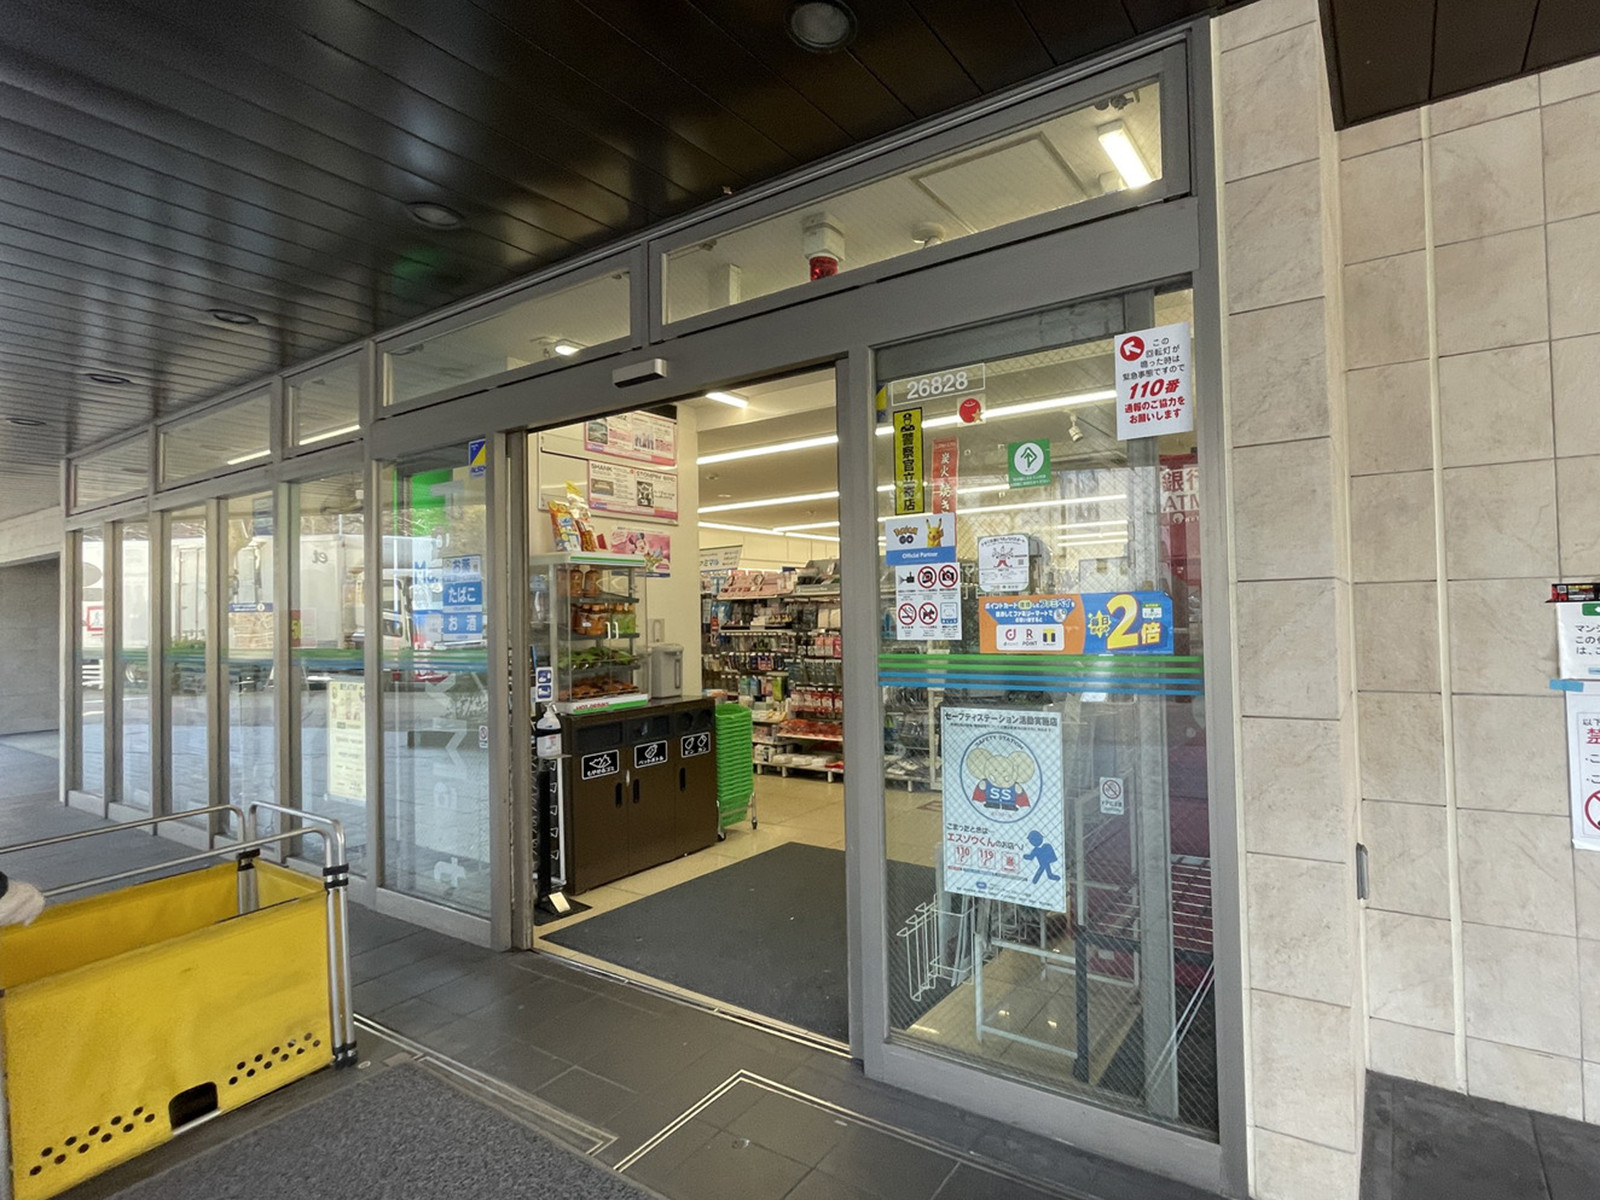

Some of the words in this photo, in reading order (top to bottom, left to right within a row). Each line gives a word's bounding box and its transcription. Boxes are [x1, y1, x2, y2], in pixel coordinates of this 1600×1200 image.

[1152, 337, 1170, 347] この
[1145, 344, 1180, 358] 回転灯が
[1140, 355, 1180, 369] 鳴った時は
[1122, 363, 1185, 381] 緊急事態ですので
[906, 371, 968, 400] 26828
[1129, 378, 1180, 400] 110番
[1124, 396, 1186, 414] 通報のご協力を
[1129, 408, 1182, 424] お願いします
[899, 535, 914, 545] GO
[920, 551, 938, 559] Partner
[448, 586, 476, 603] たばこ
[1575, 636, 1600, 645] この
[945, 713, 1058, 727] セーフティステーション活動実施店
[989, 787, 1012, 800] SS
[956, 846, 970, 857] 110
[980, 849, 994, 860] 119
